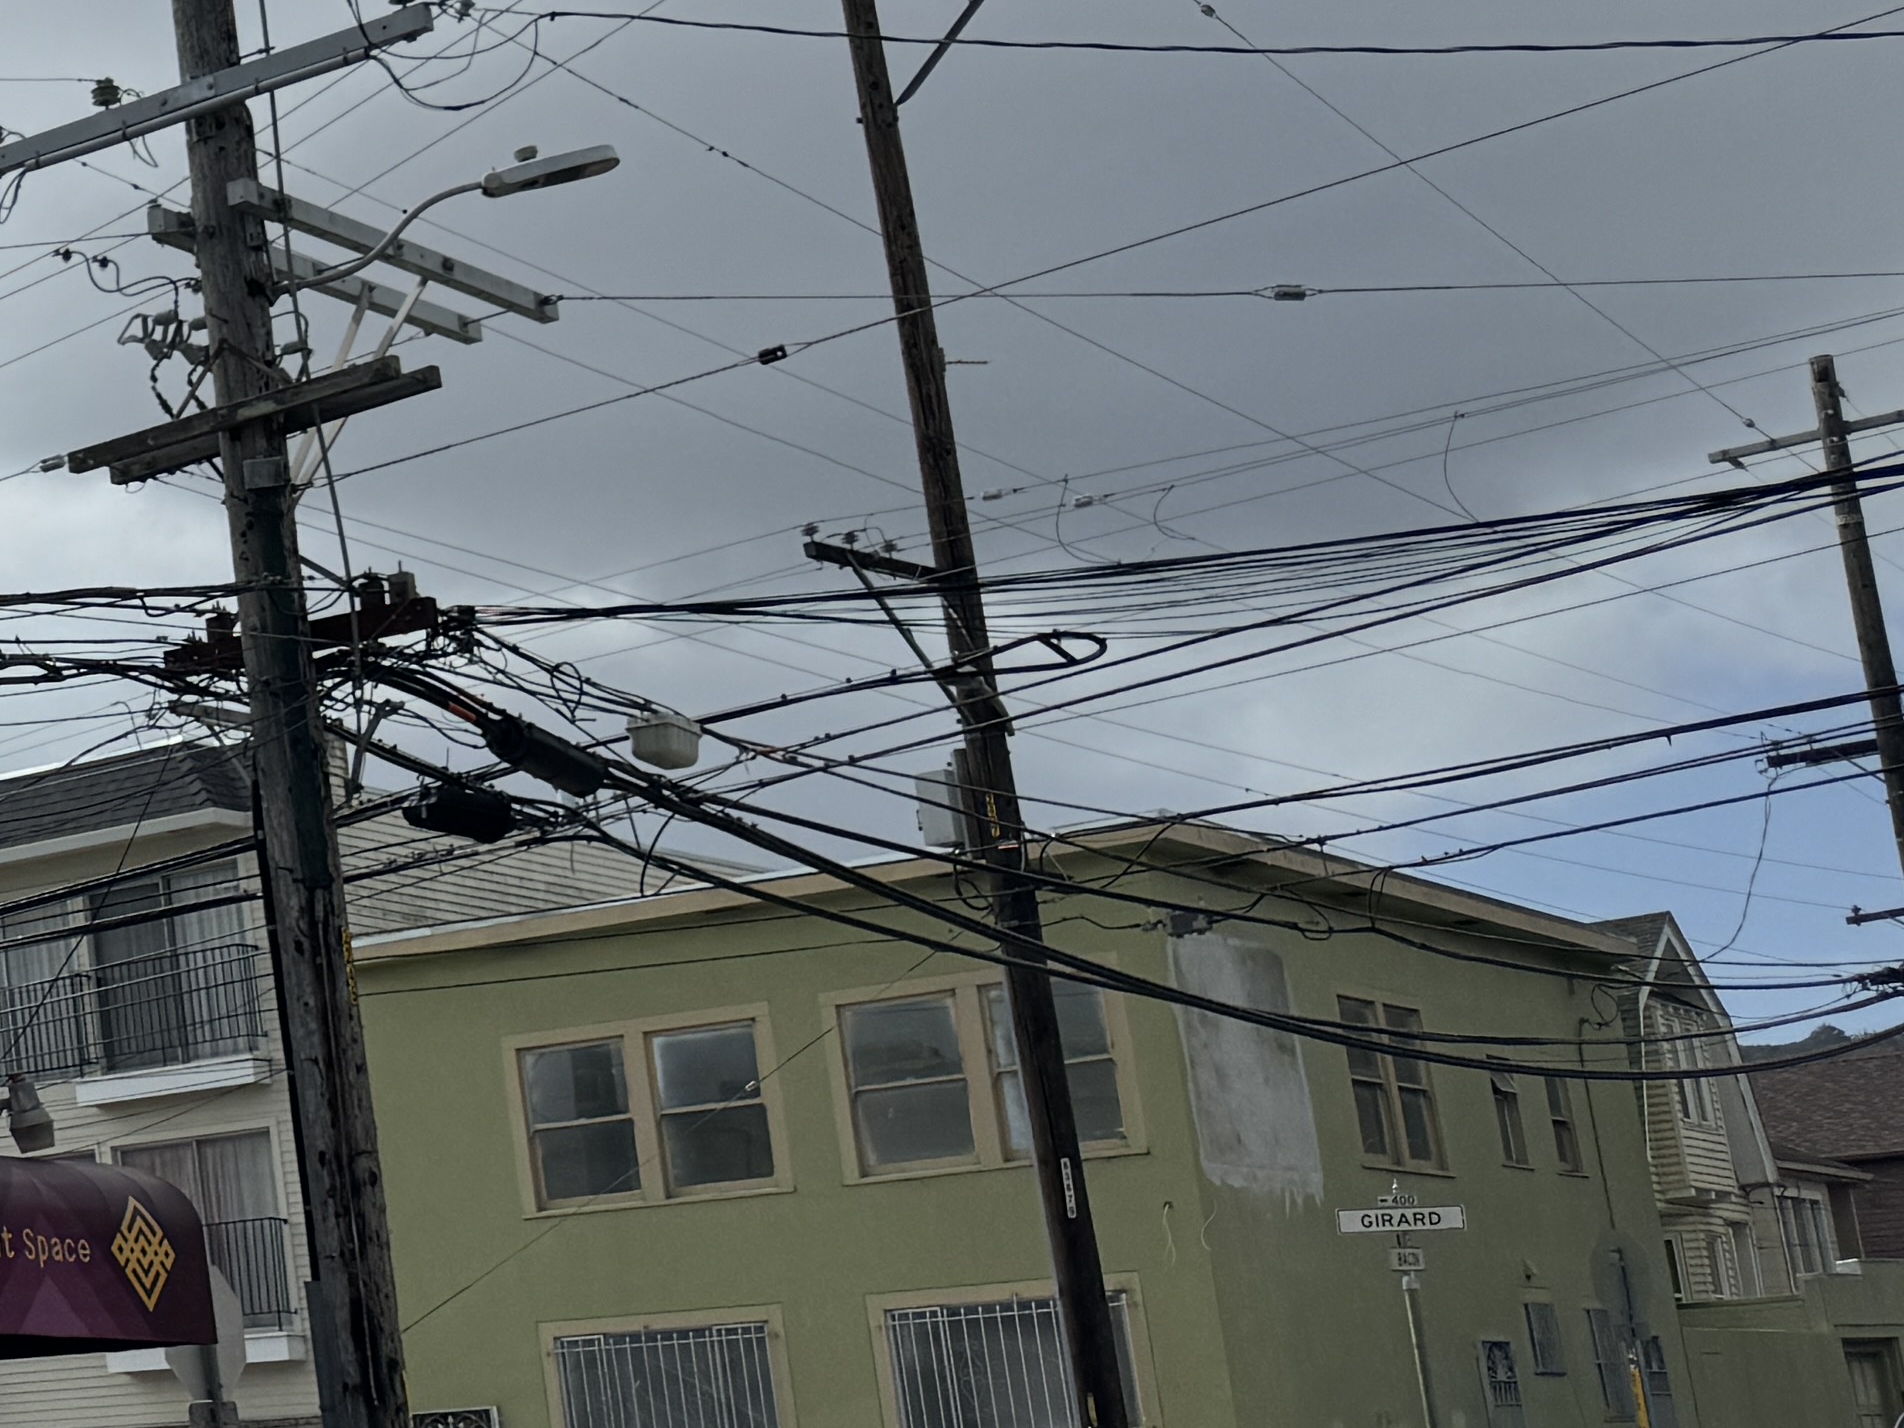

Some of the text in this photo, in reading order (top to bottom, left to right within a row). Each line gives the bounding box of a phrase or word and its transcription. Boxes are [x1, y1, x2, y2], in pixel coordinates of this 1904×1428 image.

[1392, 1196, 1415, 1205] 400
[1361, 1211, 1441, 1228] GIRARD
[23, 1236, 92, 1265] Space
